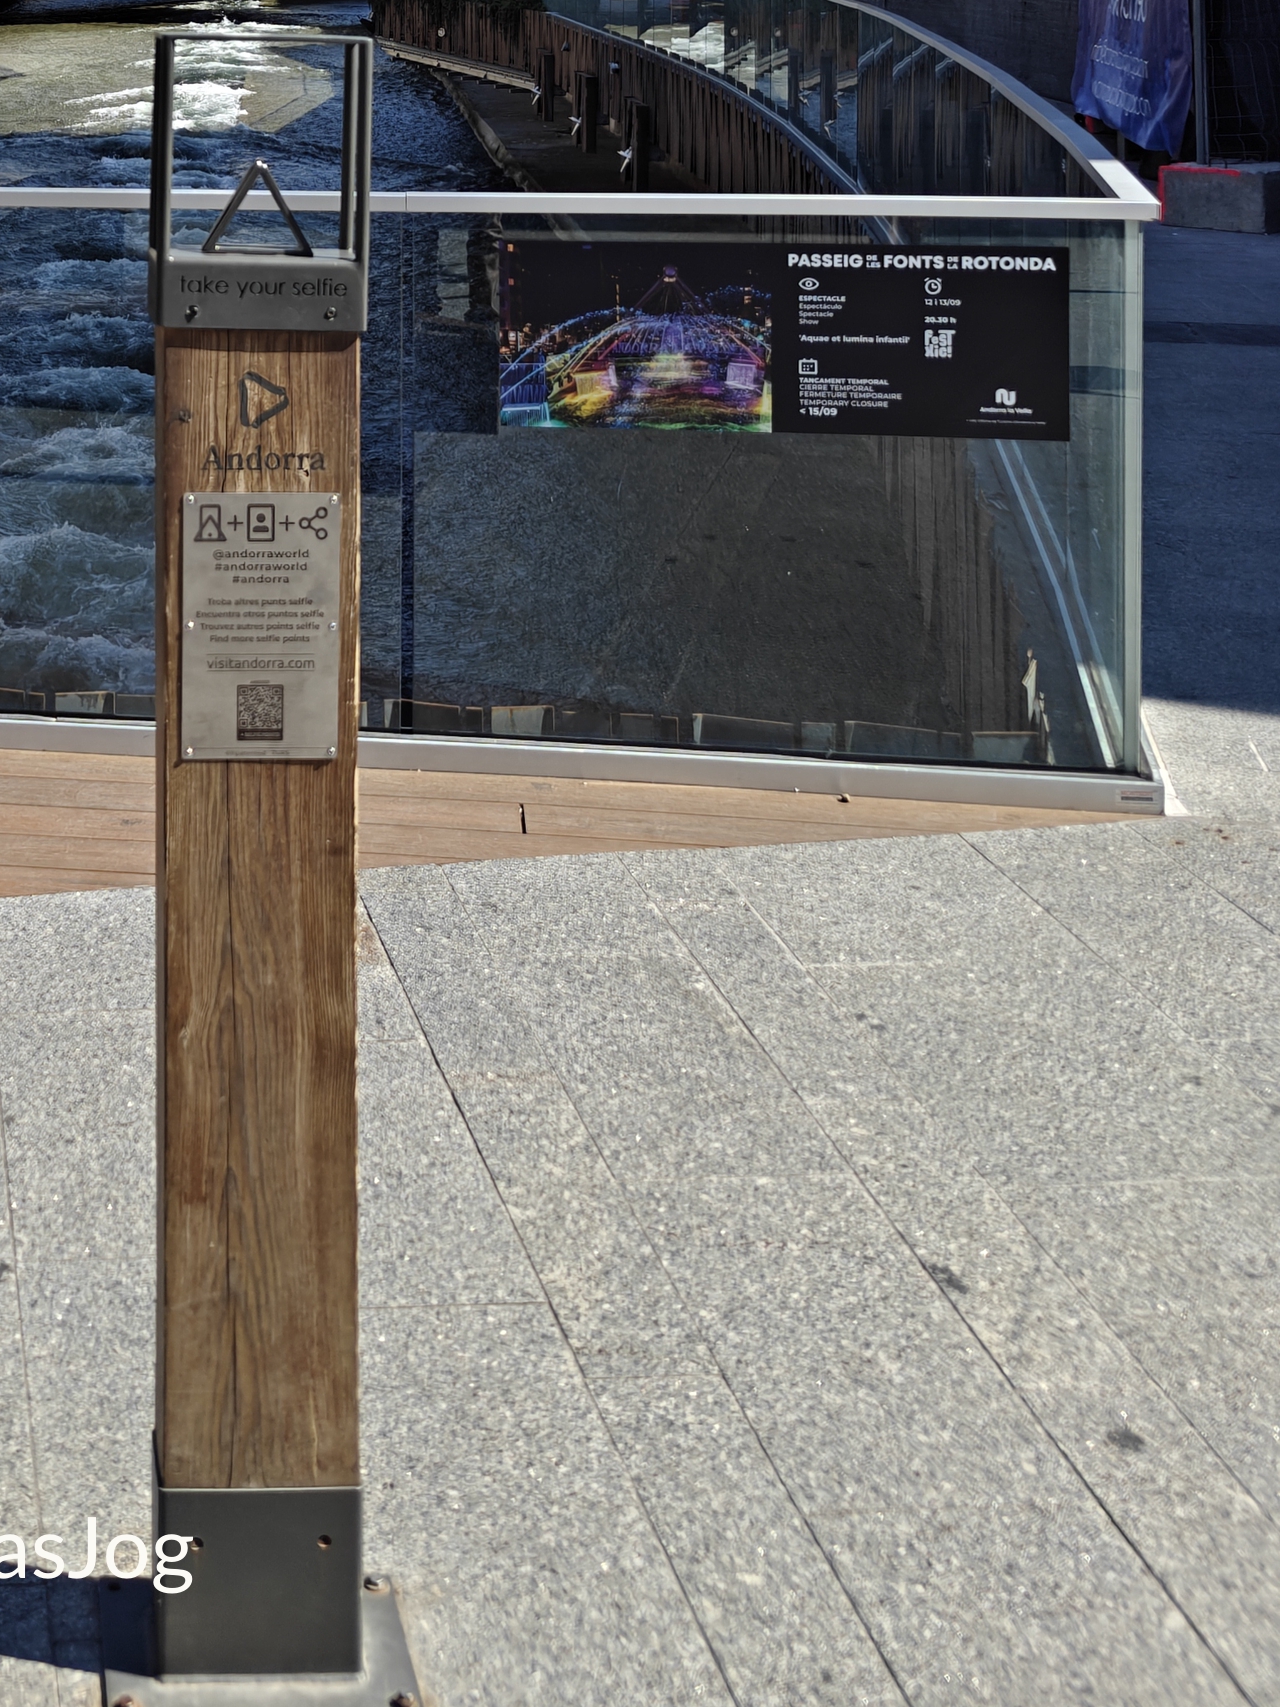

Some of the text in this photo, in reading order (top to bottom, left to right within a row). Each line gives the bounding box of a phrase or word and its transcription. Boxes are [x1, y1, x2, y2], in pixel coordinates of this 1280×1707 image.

[787, 253, 864, 268] PASSEIG
[883, 255, 945, 269] FONTS
[961, 256, 1057, 271] ROTONDA
[180, 275, 348, 298] take your selfie
[798, 303, 842, 311] Espectáculo
[924, 298, 933, 306] 12
[939, 298, 962, 307] 13/09
[798, 310, 834, 318] Spectacle
[949, 316, 957, 324] h
[842, 335, 874, 343] lumina
[847, 378, 889, 386] TEMPORAL
[799, 383, 874, 392] CIERRE TEMPORAL
[799, 390, 903, 400] FERMETURE TEMPORAIRE
[850, 399, 889, 408] CLOSURE
[808, 406, 838, 416] 15/09
[200, 444, 327, 472] Andorra
[213, 549, 310, 560] @andorraworld
[215, 562, 308, 571] #andorraworld
[232, 575, 290, 584] #andorra
[208, 598, 313, 608] Troba altres punts selfie
[267, 611, 299, 620] puntos
[300, 610, 325, 619] selfie
[200, 623, 235, 631] Trouvez
[266, 623, 294, 632] points
[296, 623, 320, 631] selfie
[210, 635, 229, 643] Find
[256, 635, 281, 643] selfie
[282, 635, 310, 644] points
[207, 656, 316, 670] visitandorra.com
